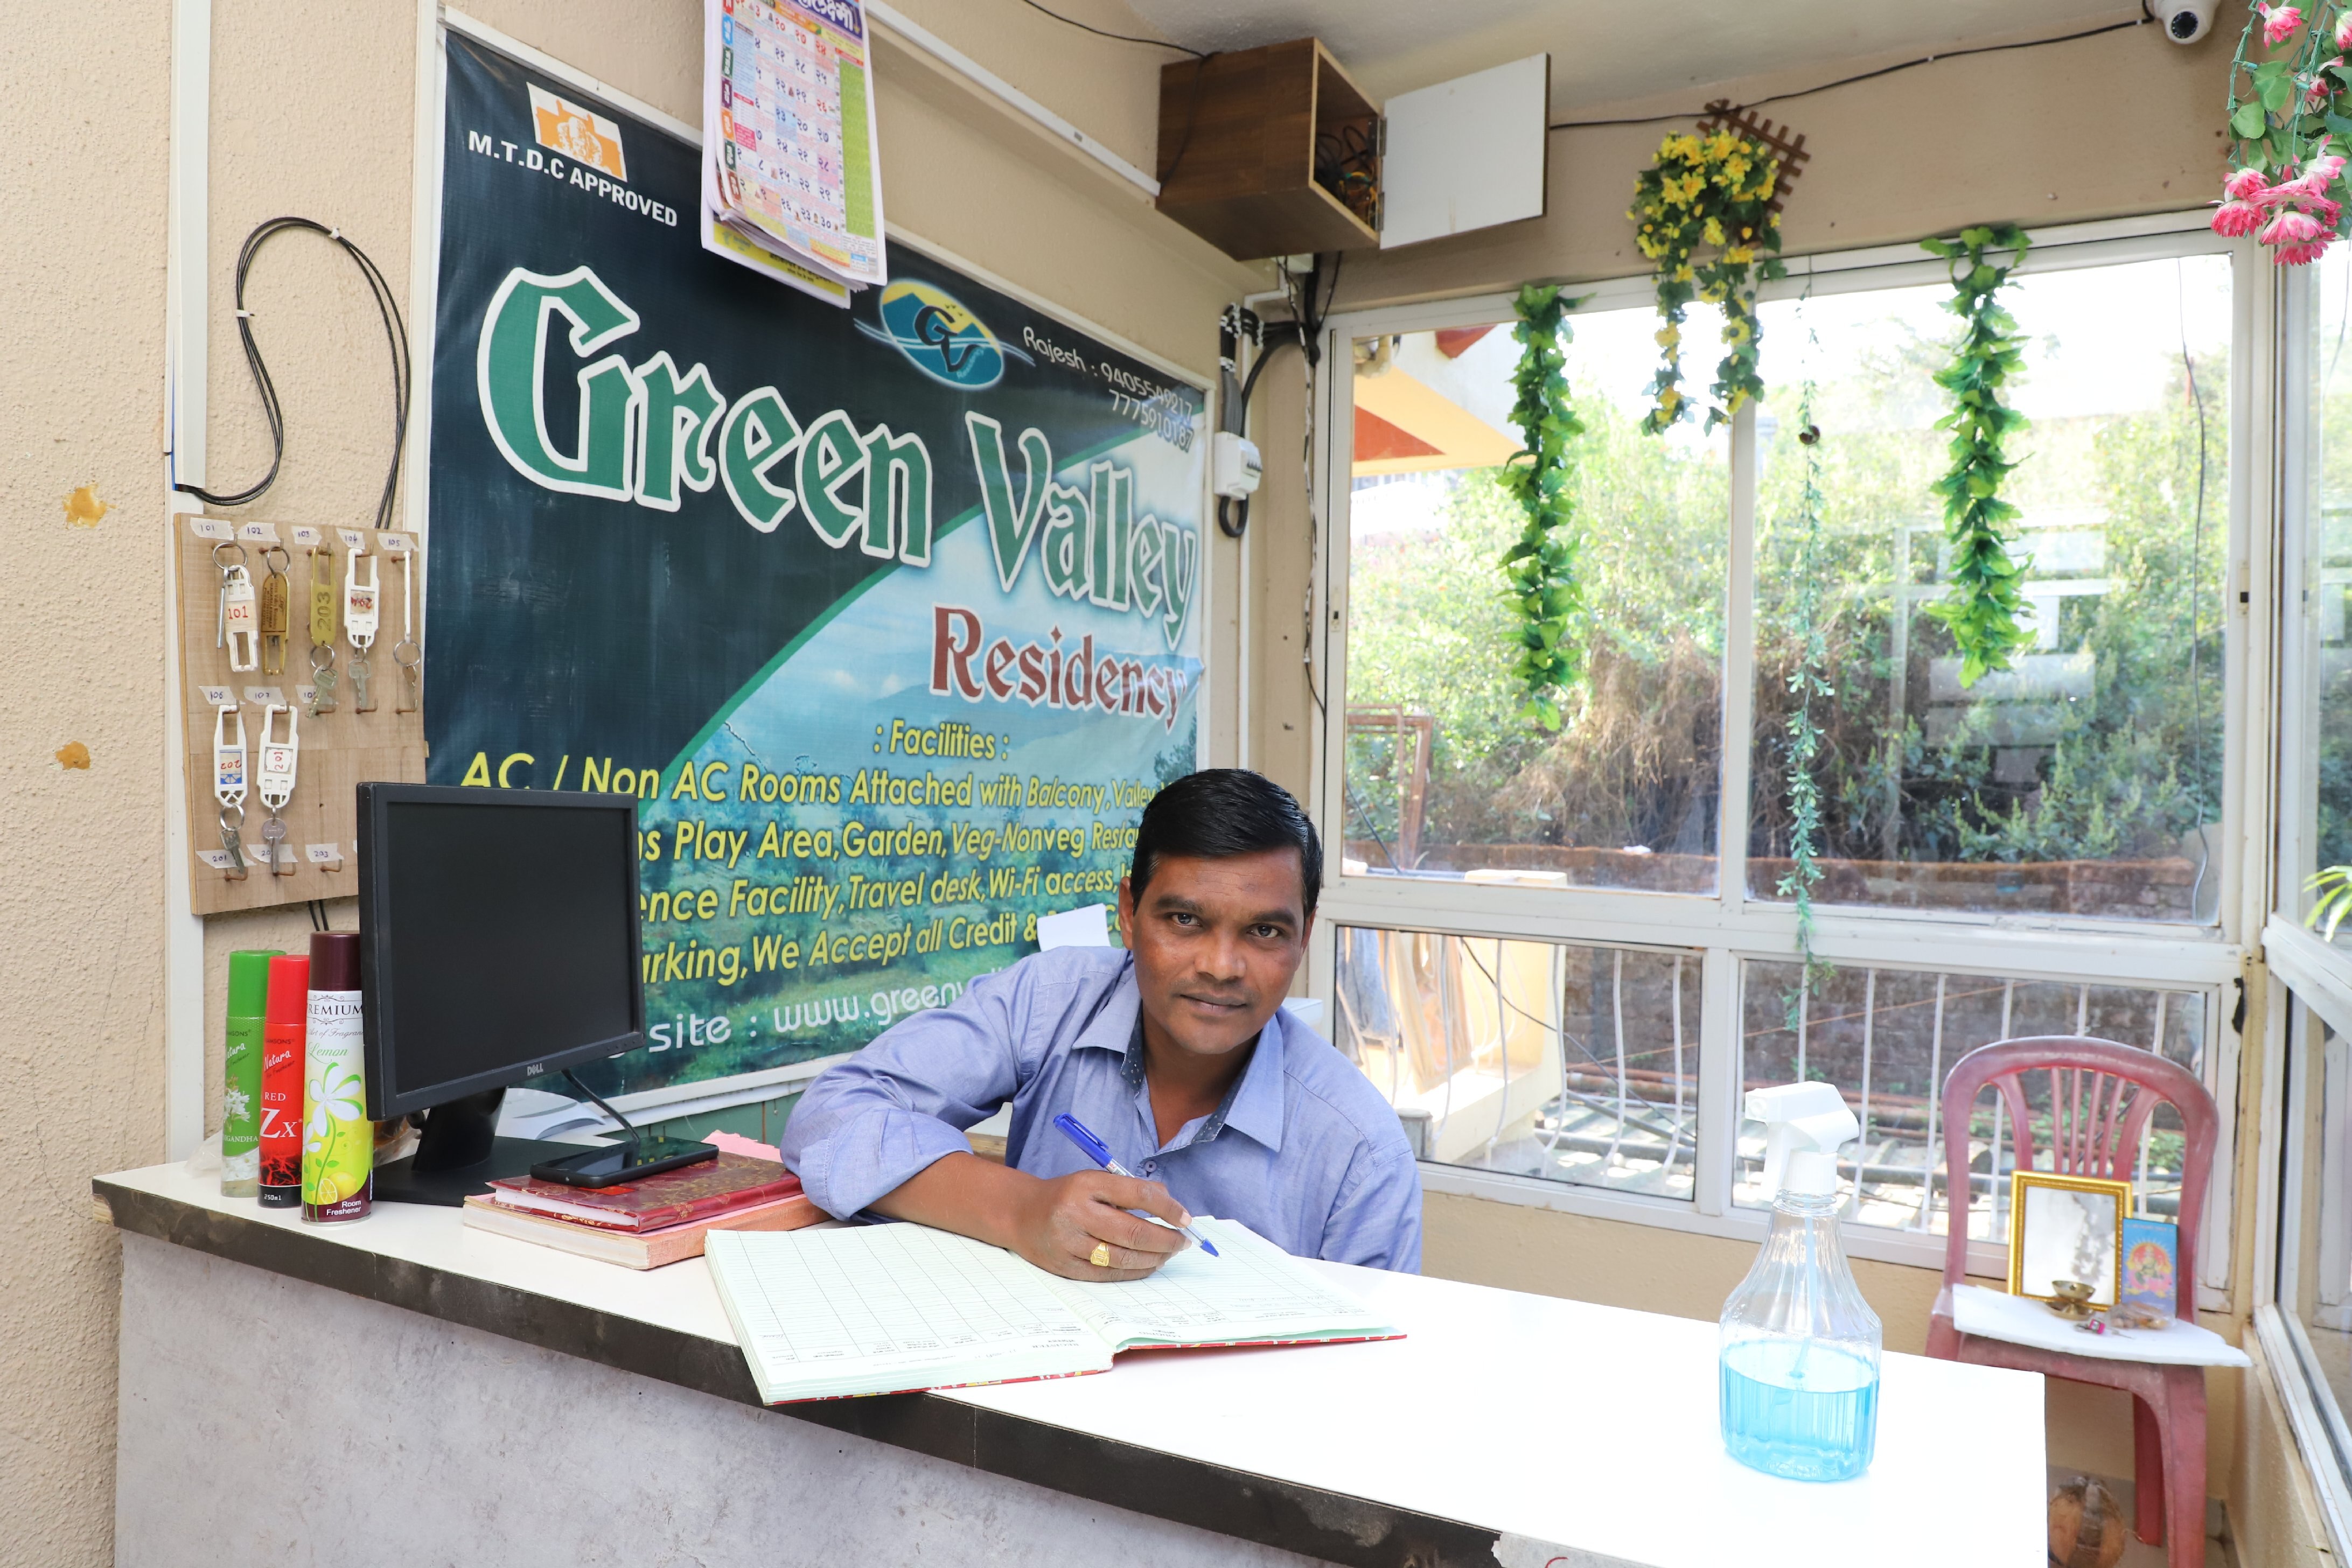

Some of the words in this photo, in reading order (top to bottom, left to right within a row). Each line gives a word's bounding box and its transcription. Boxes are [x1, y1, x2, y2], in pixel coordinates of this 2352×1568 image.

[469, 130, 565, 180] M.T.D.C
[570, 167, 678, 227] APPROVED
[1023, 326, 1087, 373] Rajesh
[1100, 362, 1192, 422] 9405549217
[1109, 389, 1194, 453] 7775910187
[477, 265, 932, 568] Green
[965, 410, 1196, 651] Valley
[200, 524, 215, 533] 101
[246, 526, 263, 535] 102
[297, 530, 310, 538] 103
[344, 534, 358, 544] 104
[388, 538, 400, 548] 105
[227, 605, 249, 620] 101
[317, 591, 331, 632] 203
[929, 601, 1187, 734] Residency
[210, 690, 224, 700] 106
[254, 691, 271, 699] 107
[889, 719, 995, 760] Facilities
[273, 751, 284, 771] 201
[460, 752, 535, 789] AC
[581, 756, 660, 799] Non
[671, 761, 729, 802] AC
[739, 763, 841, 804] Rooms
[849, 769, 971, 807] Attached
[980, 774, 1022, 807] with
[673, 820, 748, 869] Play
[212, 855, 227, 863] 201
[313, 850, 329, 858] 203
[809, 921, 909, 966] Accept
[916, 916, 943, 953] all
[948, 912, 1018, 949] Credit
[1023, 912, 1037, 942] &
[319, 1028, 330, 1039] of
[264, 1050, 291, 1070] Natura
[308, 1042, 349, 1065] Lemon
[527, 1062, 543, 1076] DELL
[264, 1092, 286, 1102] RED
[341, 1200, 361, 1208] Room
[326, 1207, 361, 1216] Freshener
